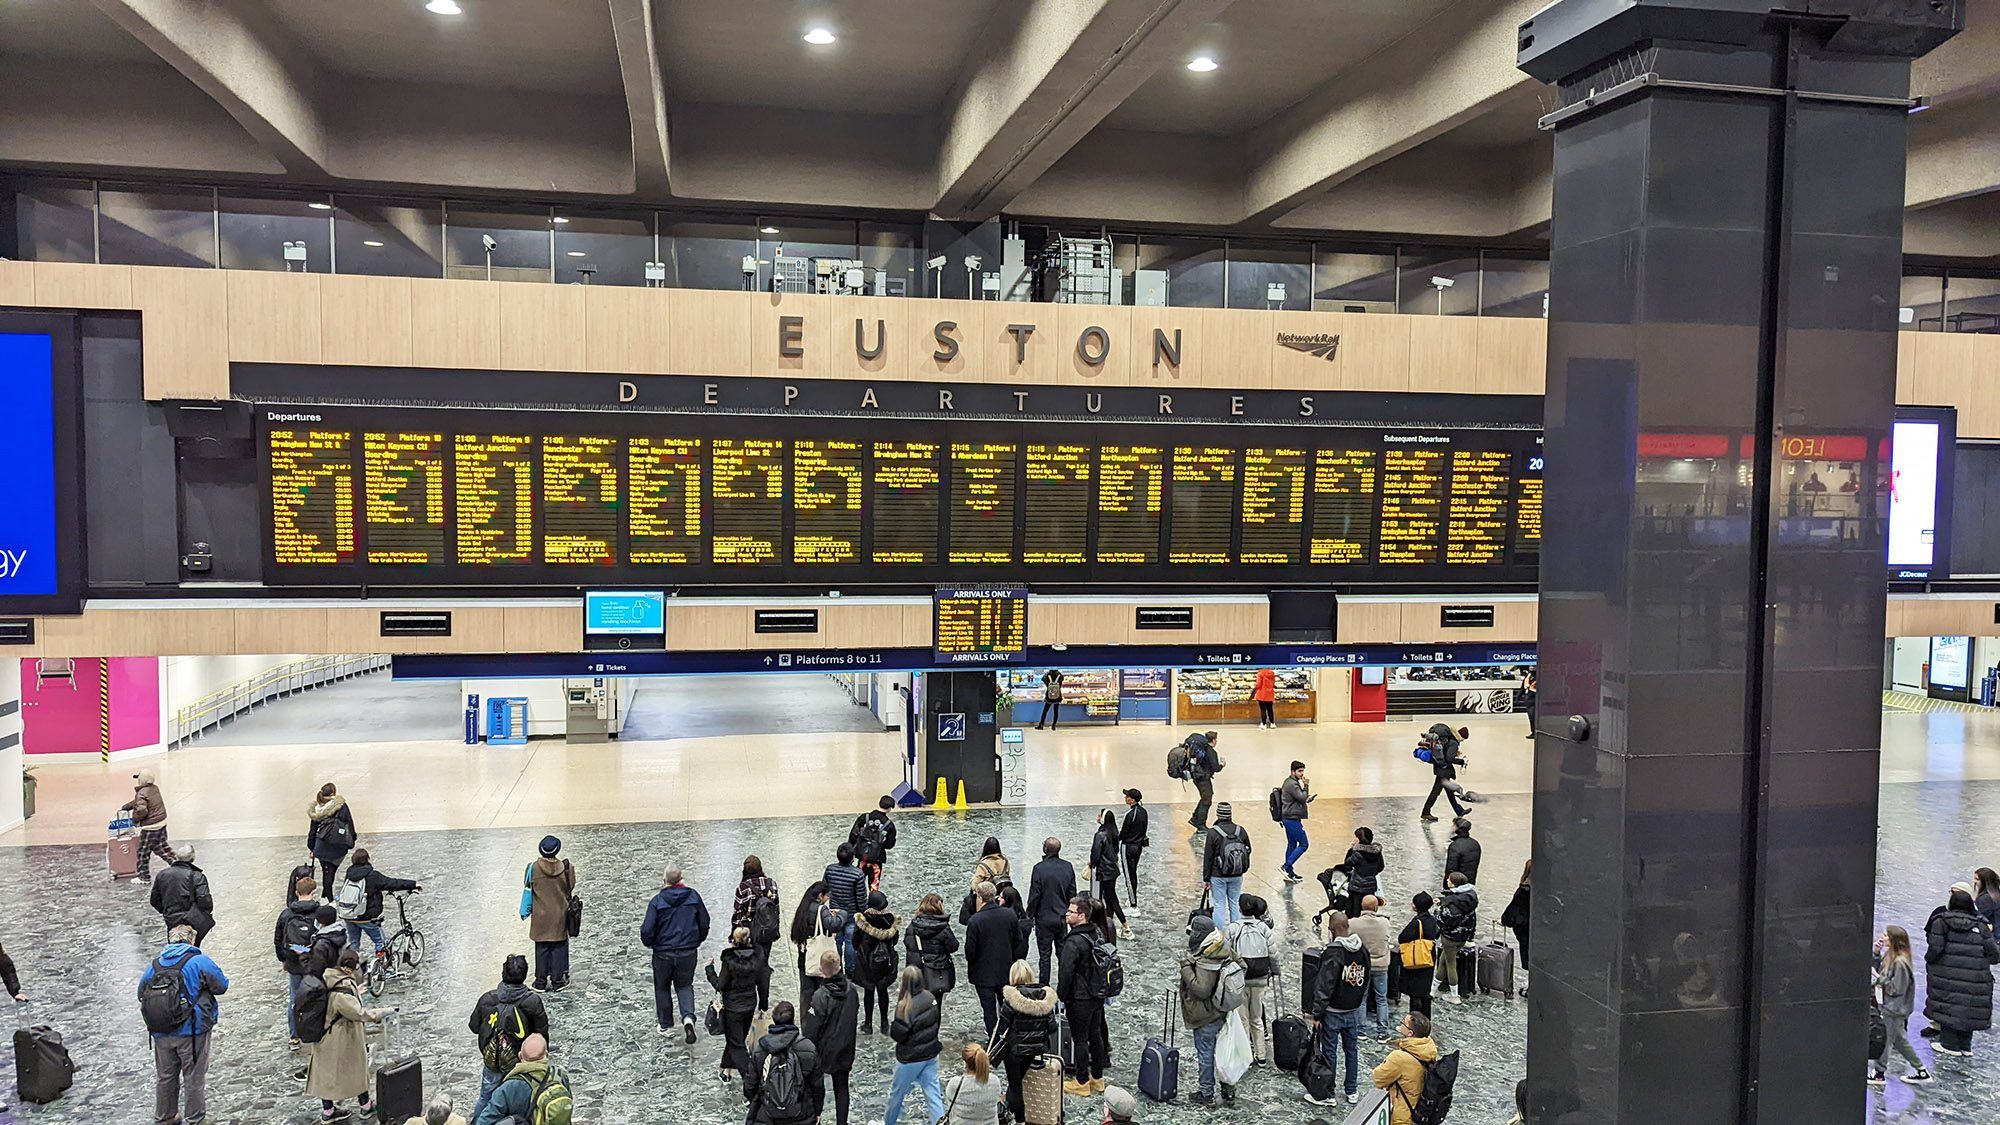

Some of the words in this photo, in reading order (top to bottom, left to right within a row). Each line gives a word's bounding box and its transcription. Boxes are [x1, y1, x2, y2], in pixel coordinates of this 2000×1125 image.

[780, 316, 1182, 366] EUSTON
[619, 382, 1314, 416] DEPARTURES
[268, 413, 321, 422] Departures
[795, 458, 826, 466] Preparing
[797, 655, 844, 664] Platforms
[847, 655, 853, 664] 8
[856, 655, 866, 663] to
[870, 654, 881, 663] 11
[1491, 698, 1510, 708] KING
